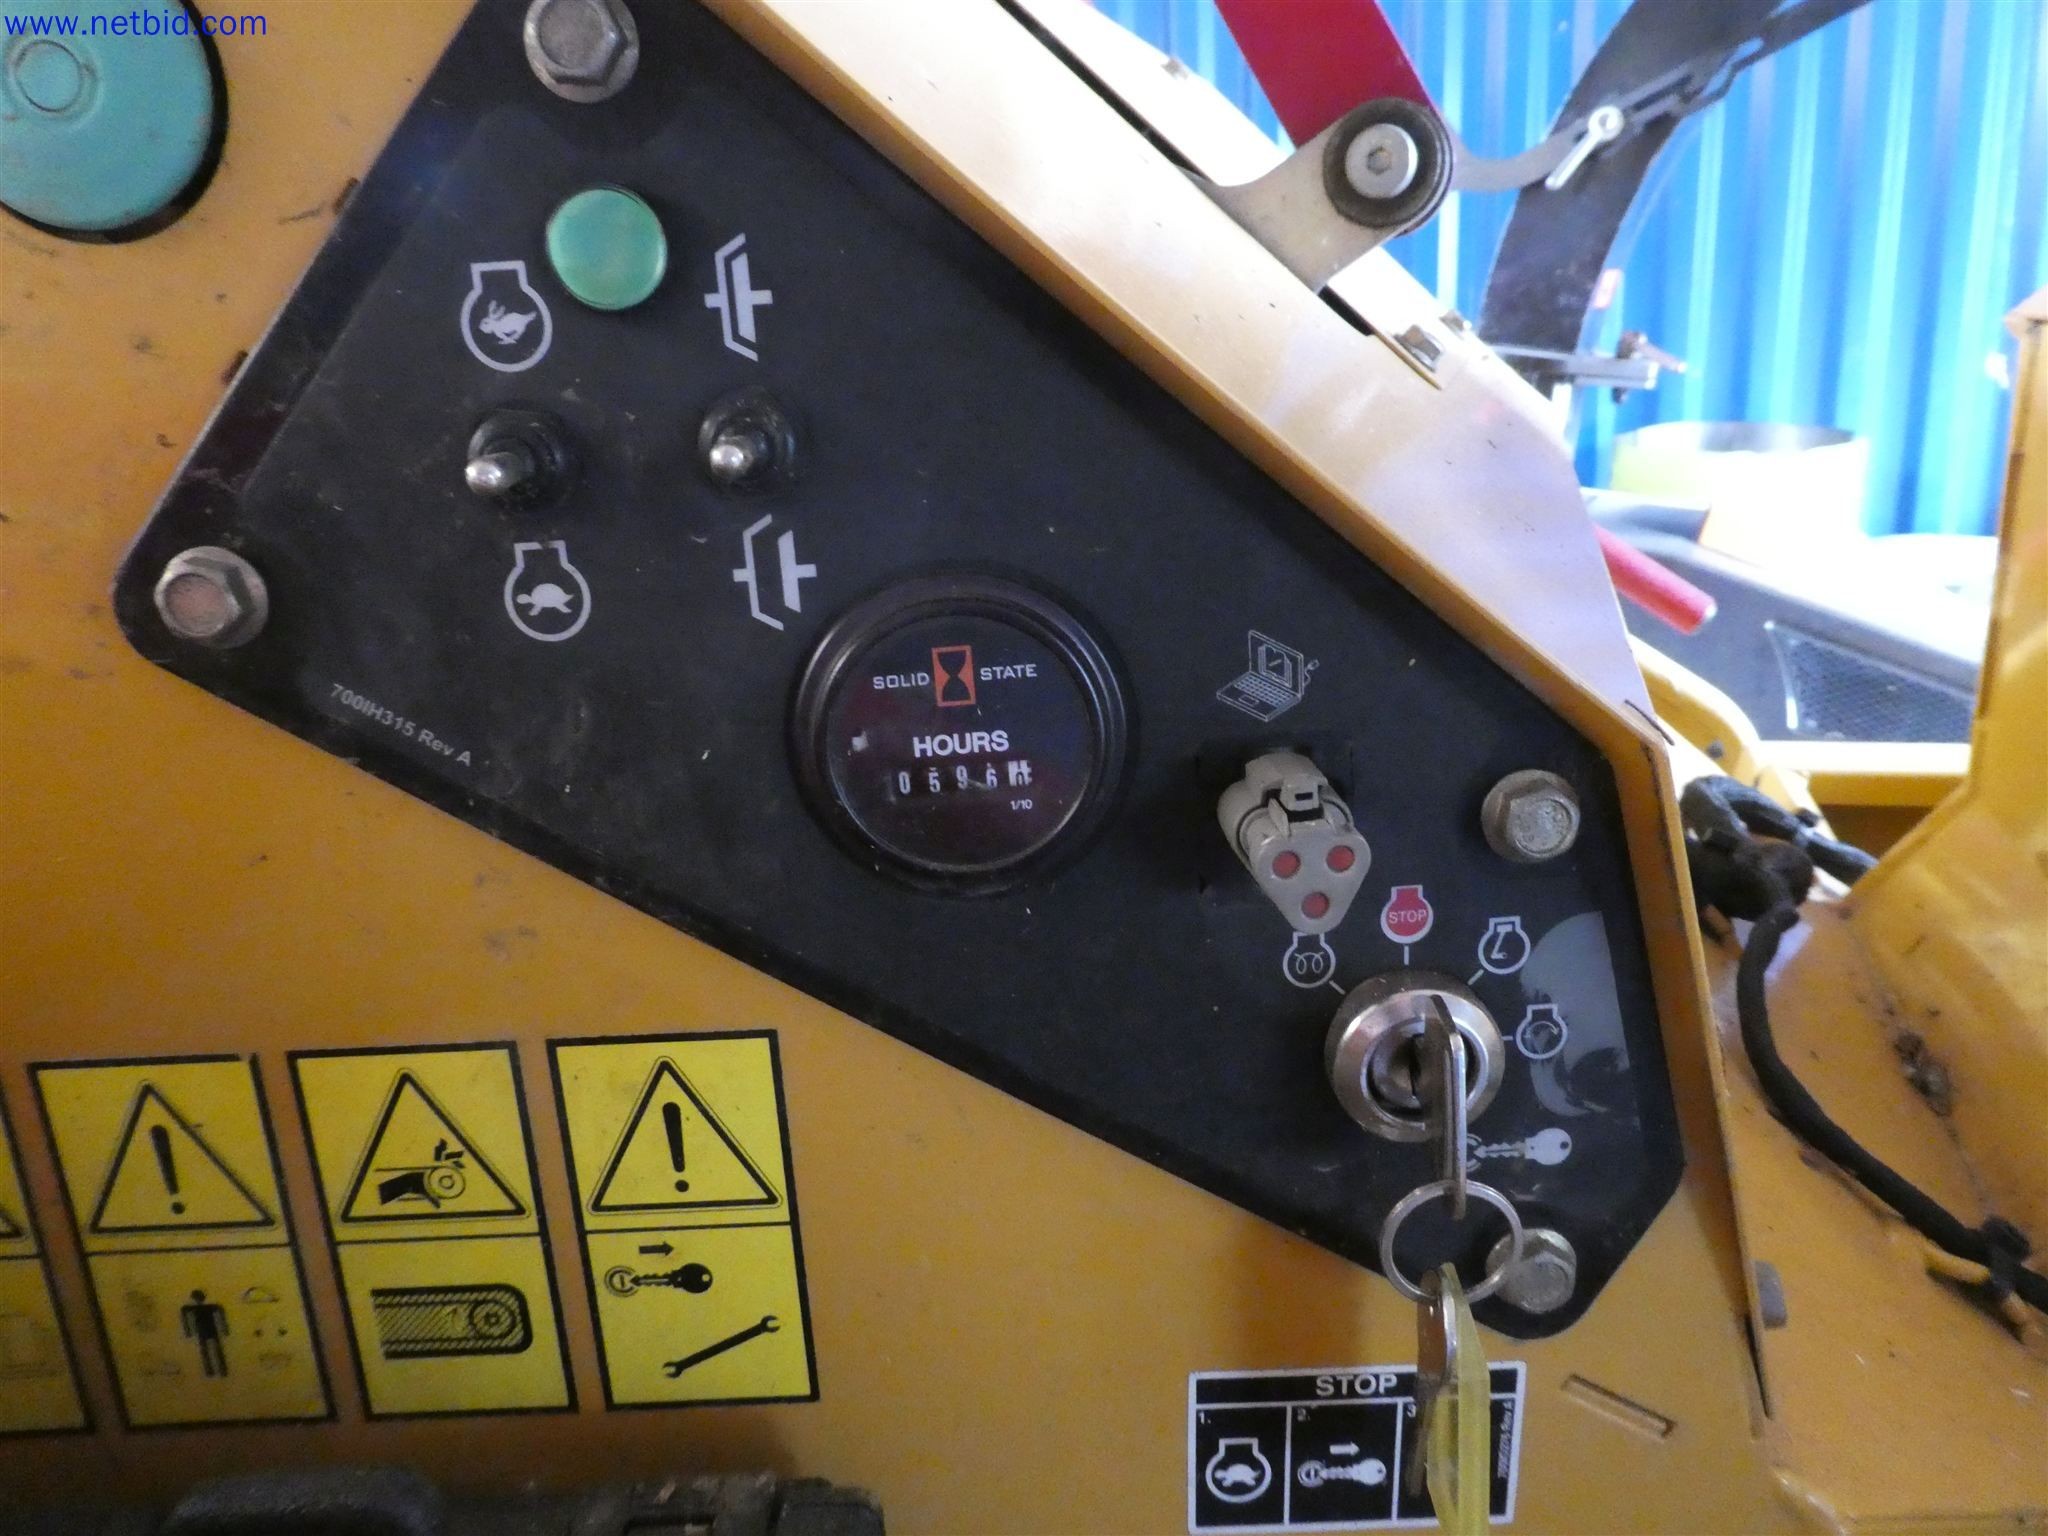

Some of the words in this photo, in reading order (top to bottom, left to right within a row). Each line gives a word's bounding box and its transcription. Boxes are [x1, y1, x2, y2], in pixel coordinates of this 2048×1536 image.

[872, 672, 930, 690] SOLID
[980, 664, 1038, 681] STATE
[418, 728, 454, 756] Rev
[455, 750, 471, 767] A
[912, 729, 1010, 758] HOURS
[1010, 799, 1033, 811] 1/10
[1388, 908, 1428, 925] STOP
[1315, 1373, 1398, 1397] STOP
